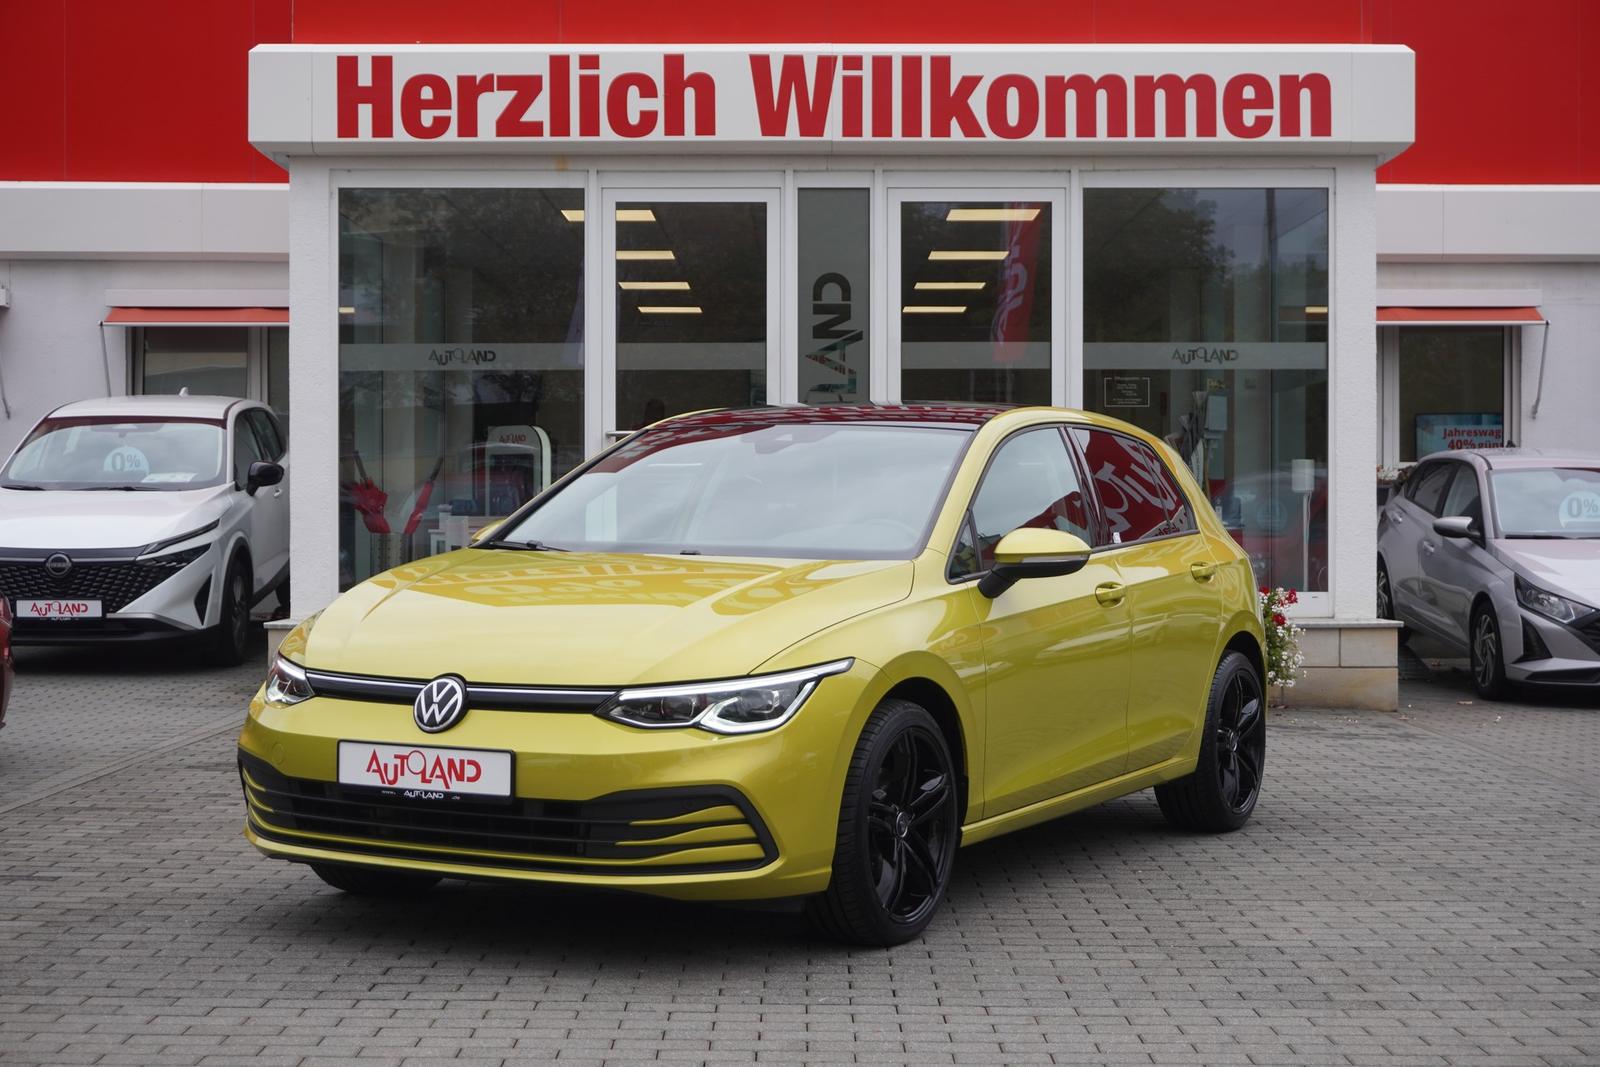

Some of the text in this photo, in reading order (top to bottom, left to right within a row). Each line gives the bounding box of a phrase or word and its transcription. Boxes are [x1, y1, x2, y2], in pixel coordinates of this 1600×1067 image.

[336, 53, 1332, 140] Herzlich Willkommen
[1443, 427, 1502, 440] Jahreswag
[112, 452, 141, 472] 0%
[1567, 497, 1599, 518] 0%
